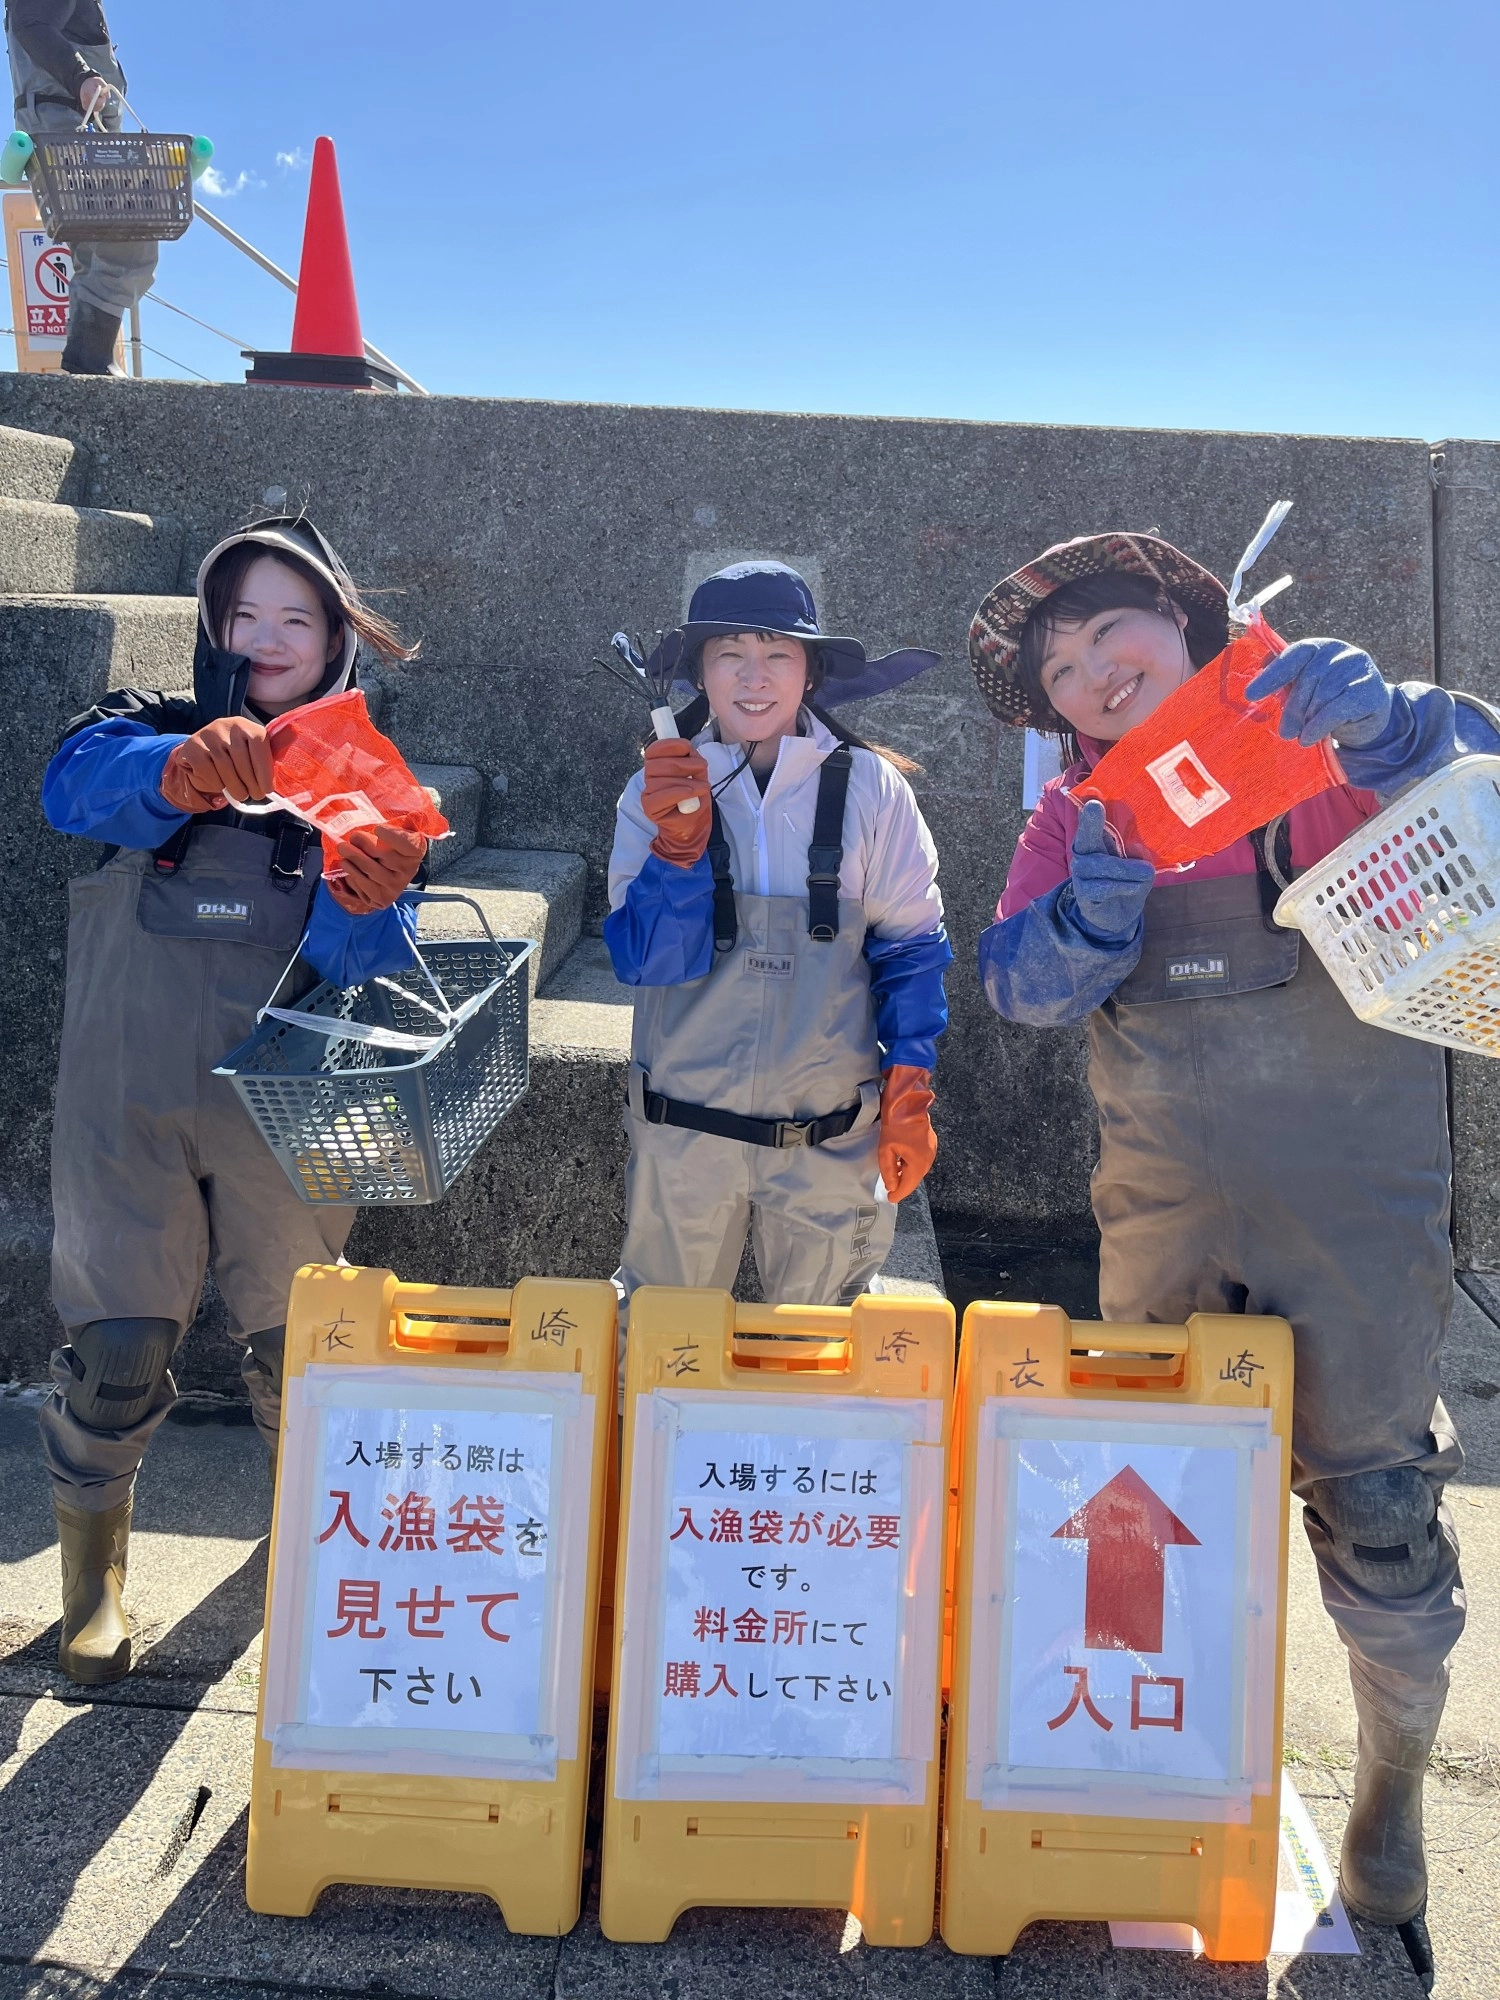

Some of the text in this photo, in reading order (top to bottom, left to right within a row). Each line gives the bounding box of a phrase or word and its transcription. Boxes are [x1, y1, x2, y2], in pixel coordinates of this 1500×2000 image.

[322, 1308, 577, 1350] 衣 崎
[667, 1329, 919, 1377] 衣 崎
[1010, 1348, 1264, 1388] 衣 崎
[346, 1440, 525, 1473] 入場する際は
[699, 1462, 877, 1495] 入場するには
[315, 1490, 548, 1557] 入漁袋を
[669, 1507, 901, 1550] 入漁袋が必要
[741, 1564, 811, 1593] です。
[327, 1579, 519, 1643] 見せて
[692, 1606, 867, 1646] 料金所にて
[359, 1667, 482, 1705] 下さい
[664, 1661, 892, 1703] 購入して下さい
[1047, 1666, 1184, 1732] 入口
